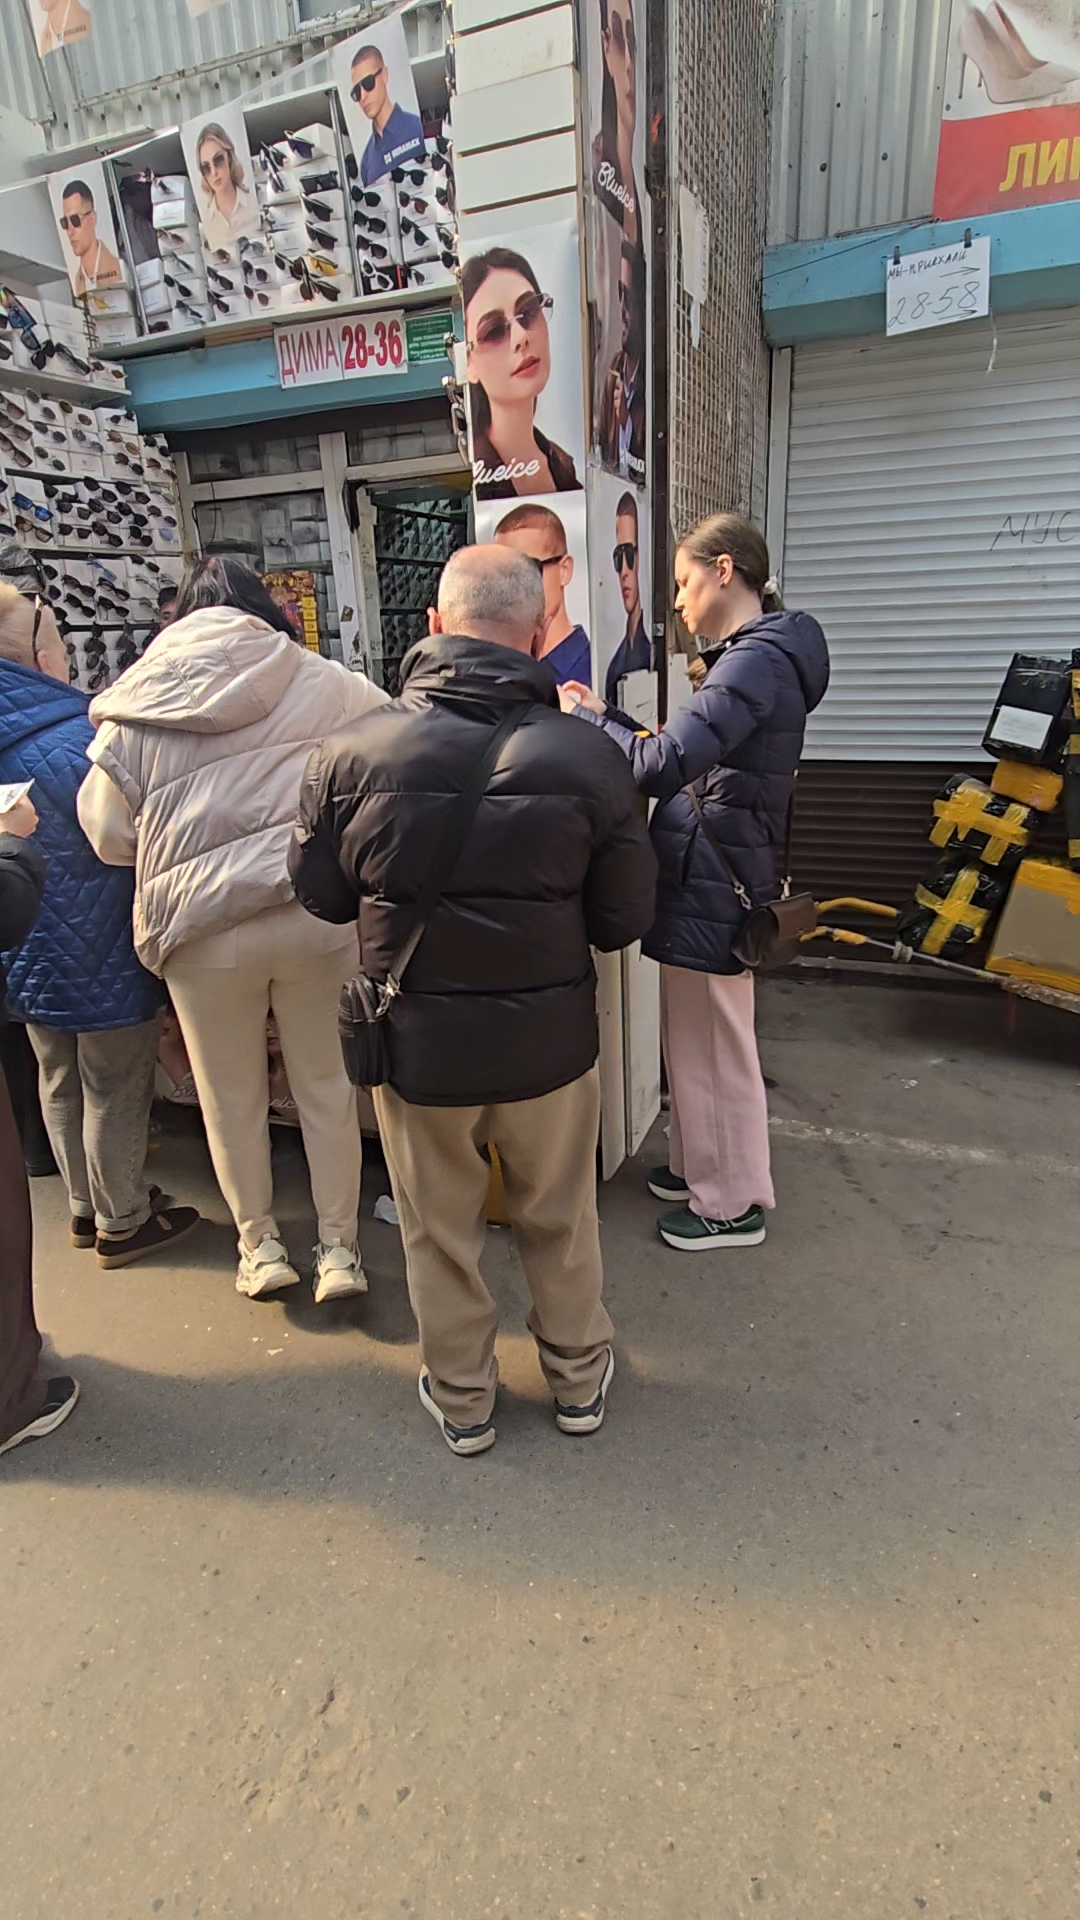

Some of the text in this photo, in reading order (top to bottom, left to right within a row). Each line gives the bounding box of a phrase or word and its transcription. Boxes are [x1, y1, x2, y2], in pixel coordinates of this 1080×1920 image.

[598, 161, 635, 213] Blueice
[887, 281, 980, 328] 28-58
[278, 319, 403, 385] ДИМА 28-36
[472, 458, 541, 484] lueice
